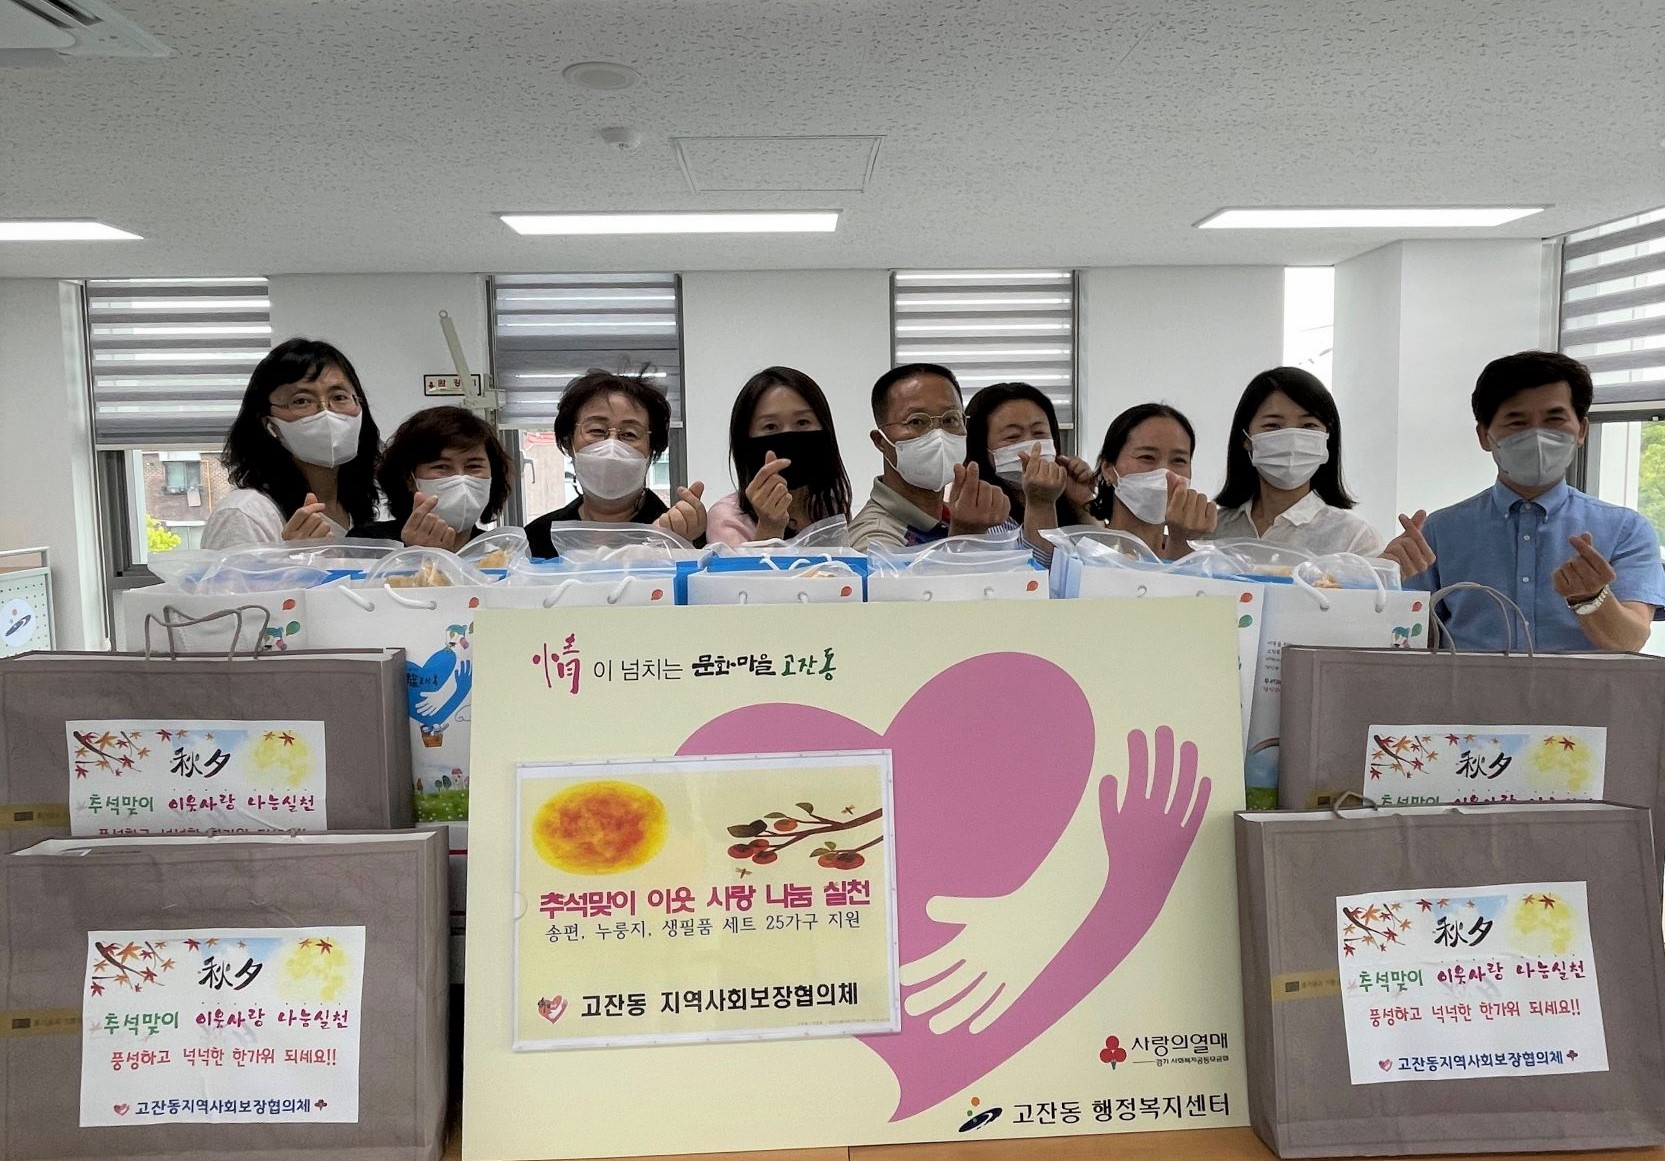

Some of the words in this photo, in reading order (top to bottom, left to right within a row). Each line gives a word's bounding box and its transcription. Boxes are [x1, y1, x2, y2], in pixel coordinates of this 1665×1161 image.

[594, 659, 612, 681] 이
[621, 658, 683, 681] 넘치는
[781, 647, 836, 681] 고잔동
[170, 746, 231, 778] 秋夕
[1456, 750, 1512, 779] 秋夕
[88, 794, 154, 816] 추석맞이
[168, 794, 236, 811] 이웃사랑
[247, 794, 316, 811] 나눔실천
[539, 890, 636, 919] 추석맞이
[647, 886, 695, 914] 이웃
[706, 884, 756, 912] 사랑
[766, 883, 813, 908] 나눔
[823, 879, 872, 906] 실천
[545, 920, 586, 942] 송편,
[595, 919, 652, 940] 누룽지,
[661, 917, 714, 938] 생필품
[722, 916, 757, 934] 세트
[766, 913, 819, 931] 25가구
[828, 910, 861, 929] 지원
[1433, 916, 1493, 947] 秋夕
[198, 956, 263, 990] 秋夕
[1359, 970, 1424, 992] 추석맞이
[1437, 962, 1504, 984] 이웃사랑
[1516, 960, 1587, 981] 나눔실천
[581, 993, 647, 1017] 고잔동
[660, 982, 858, 1014] 지역사회보장협의체
[1369, 1006, 1422, 1028] 풍성하고
[1432, 1003, 1472, 1023] 넉넉한
[1479, 1002, 1521, 1021] 한가위
[1529, 999, 1581, 1016] 되세요!!
[104, 1011, 178, 1035] 추석맞이
[195, 1009, 265, 1029] 이웃사랑
[277, 1009, 349, 1029] 나눔실천
[110, 1050, 171, 1071] 풍성하고
[183, 1047, 224, 1066] 넉넉한
[232, 1048, 275, 1067] 한가위
[284, 1048, 337, 1066] 되세요!!
[1131, 1033, 1229, 1056] 사랑의열매
[1397, 1052, 1563, 1071] 고잔동지역사회보장협의체
[135, 1098, 311, 1116] 고잔동지역사회보장협의체
[1012, 1101, 1081, 1125] 고잔동
[1092, 1093, 1230, 1122] 행정복지센터
